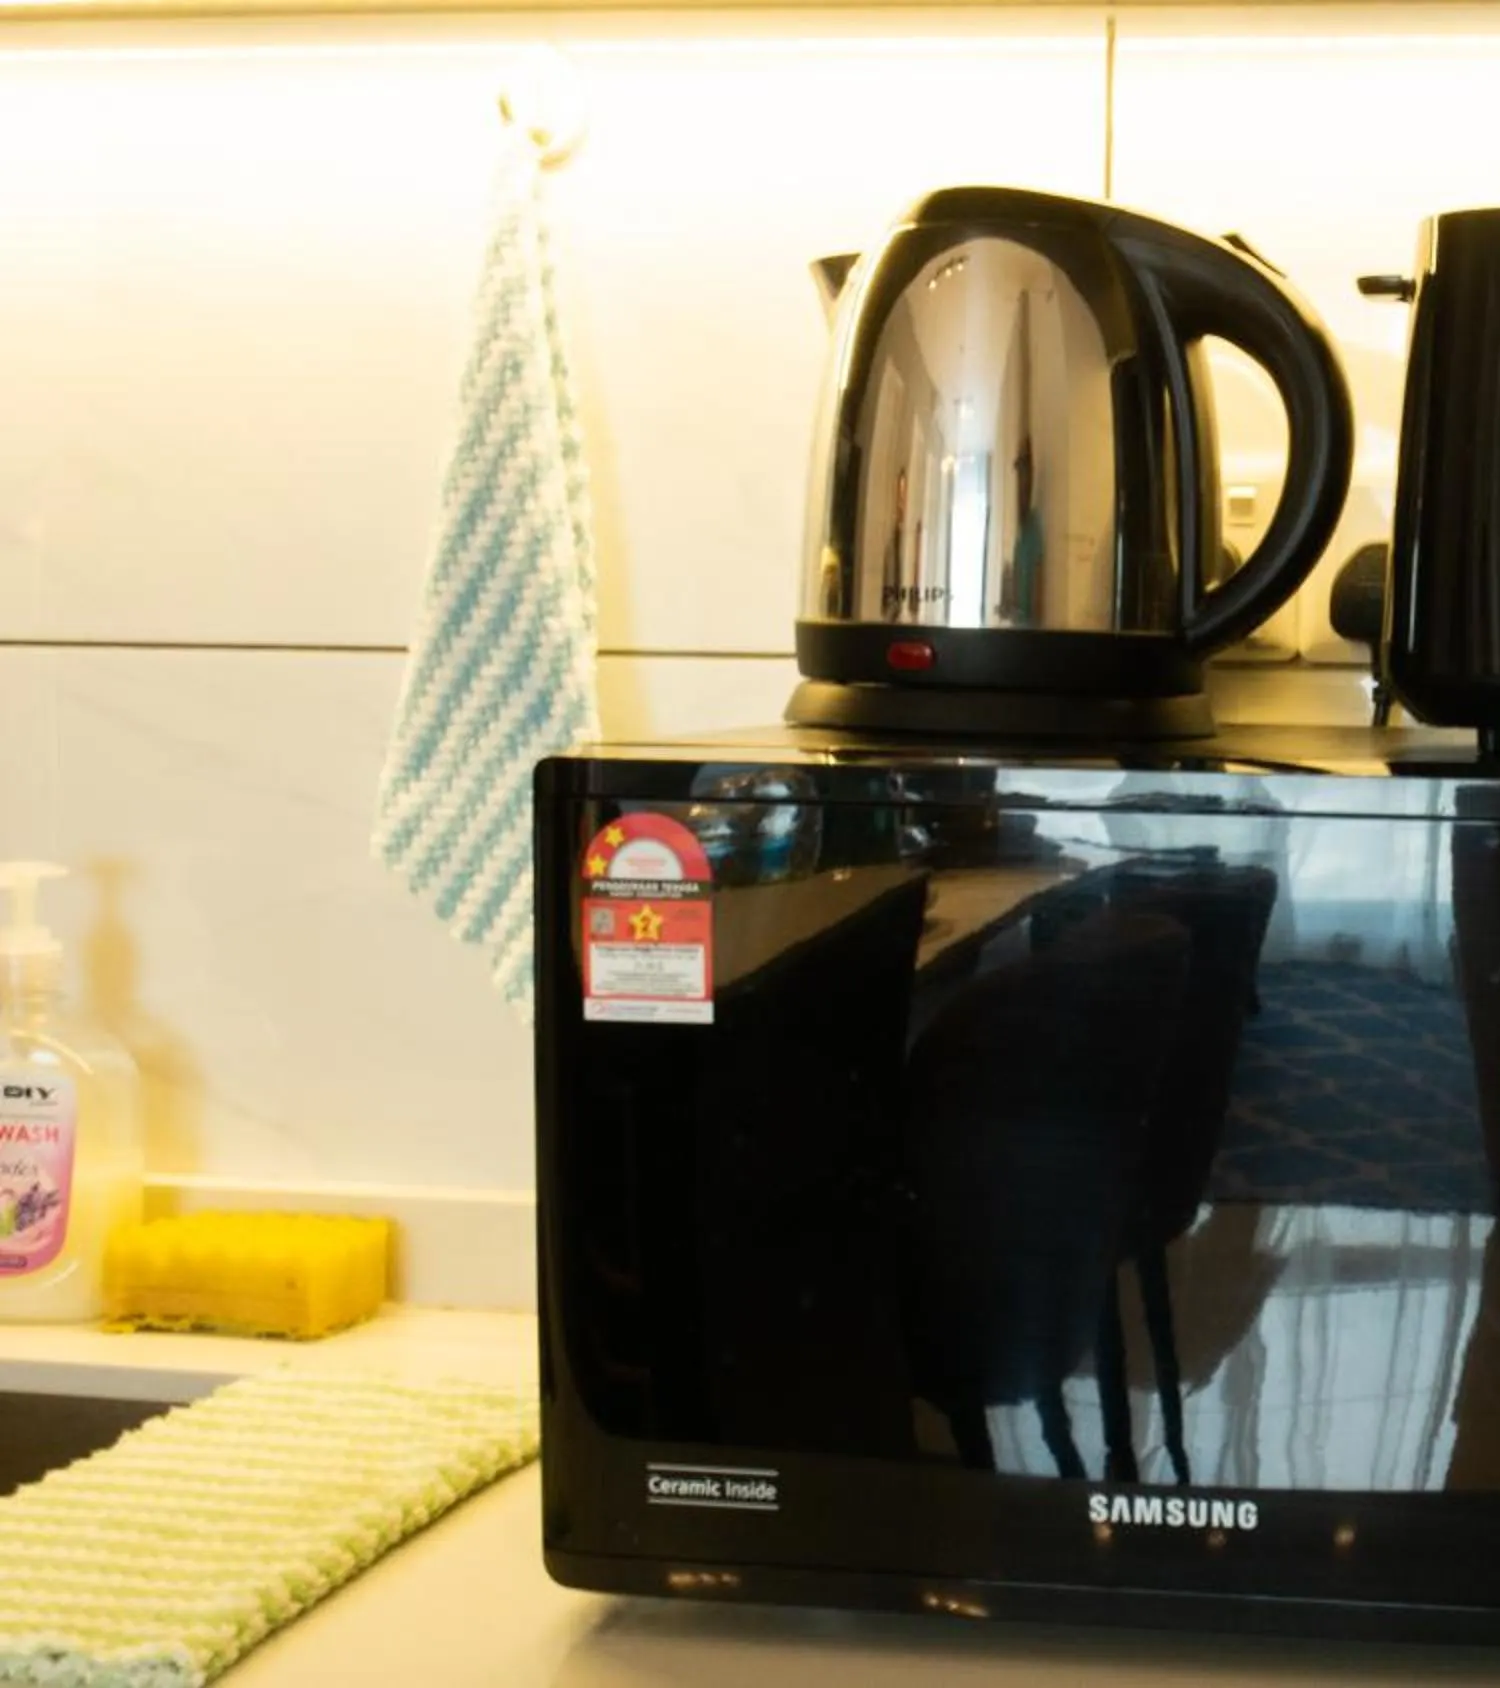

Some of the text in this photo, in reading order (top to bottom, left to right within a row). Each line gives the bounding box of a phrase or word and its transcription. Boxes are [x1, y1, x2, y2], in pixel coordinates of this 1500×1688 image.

[3, 1085, 58, 1101] DIY
[648, 1475, 777, 1501] Ceramic Inside
[1088, 1493, 1259, 1530] SAMSUNG
